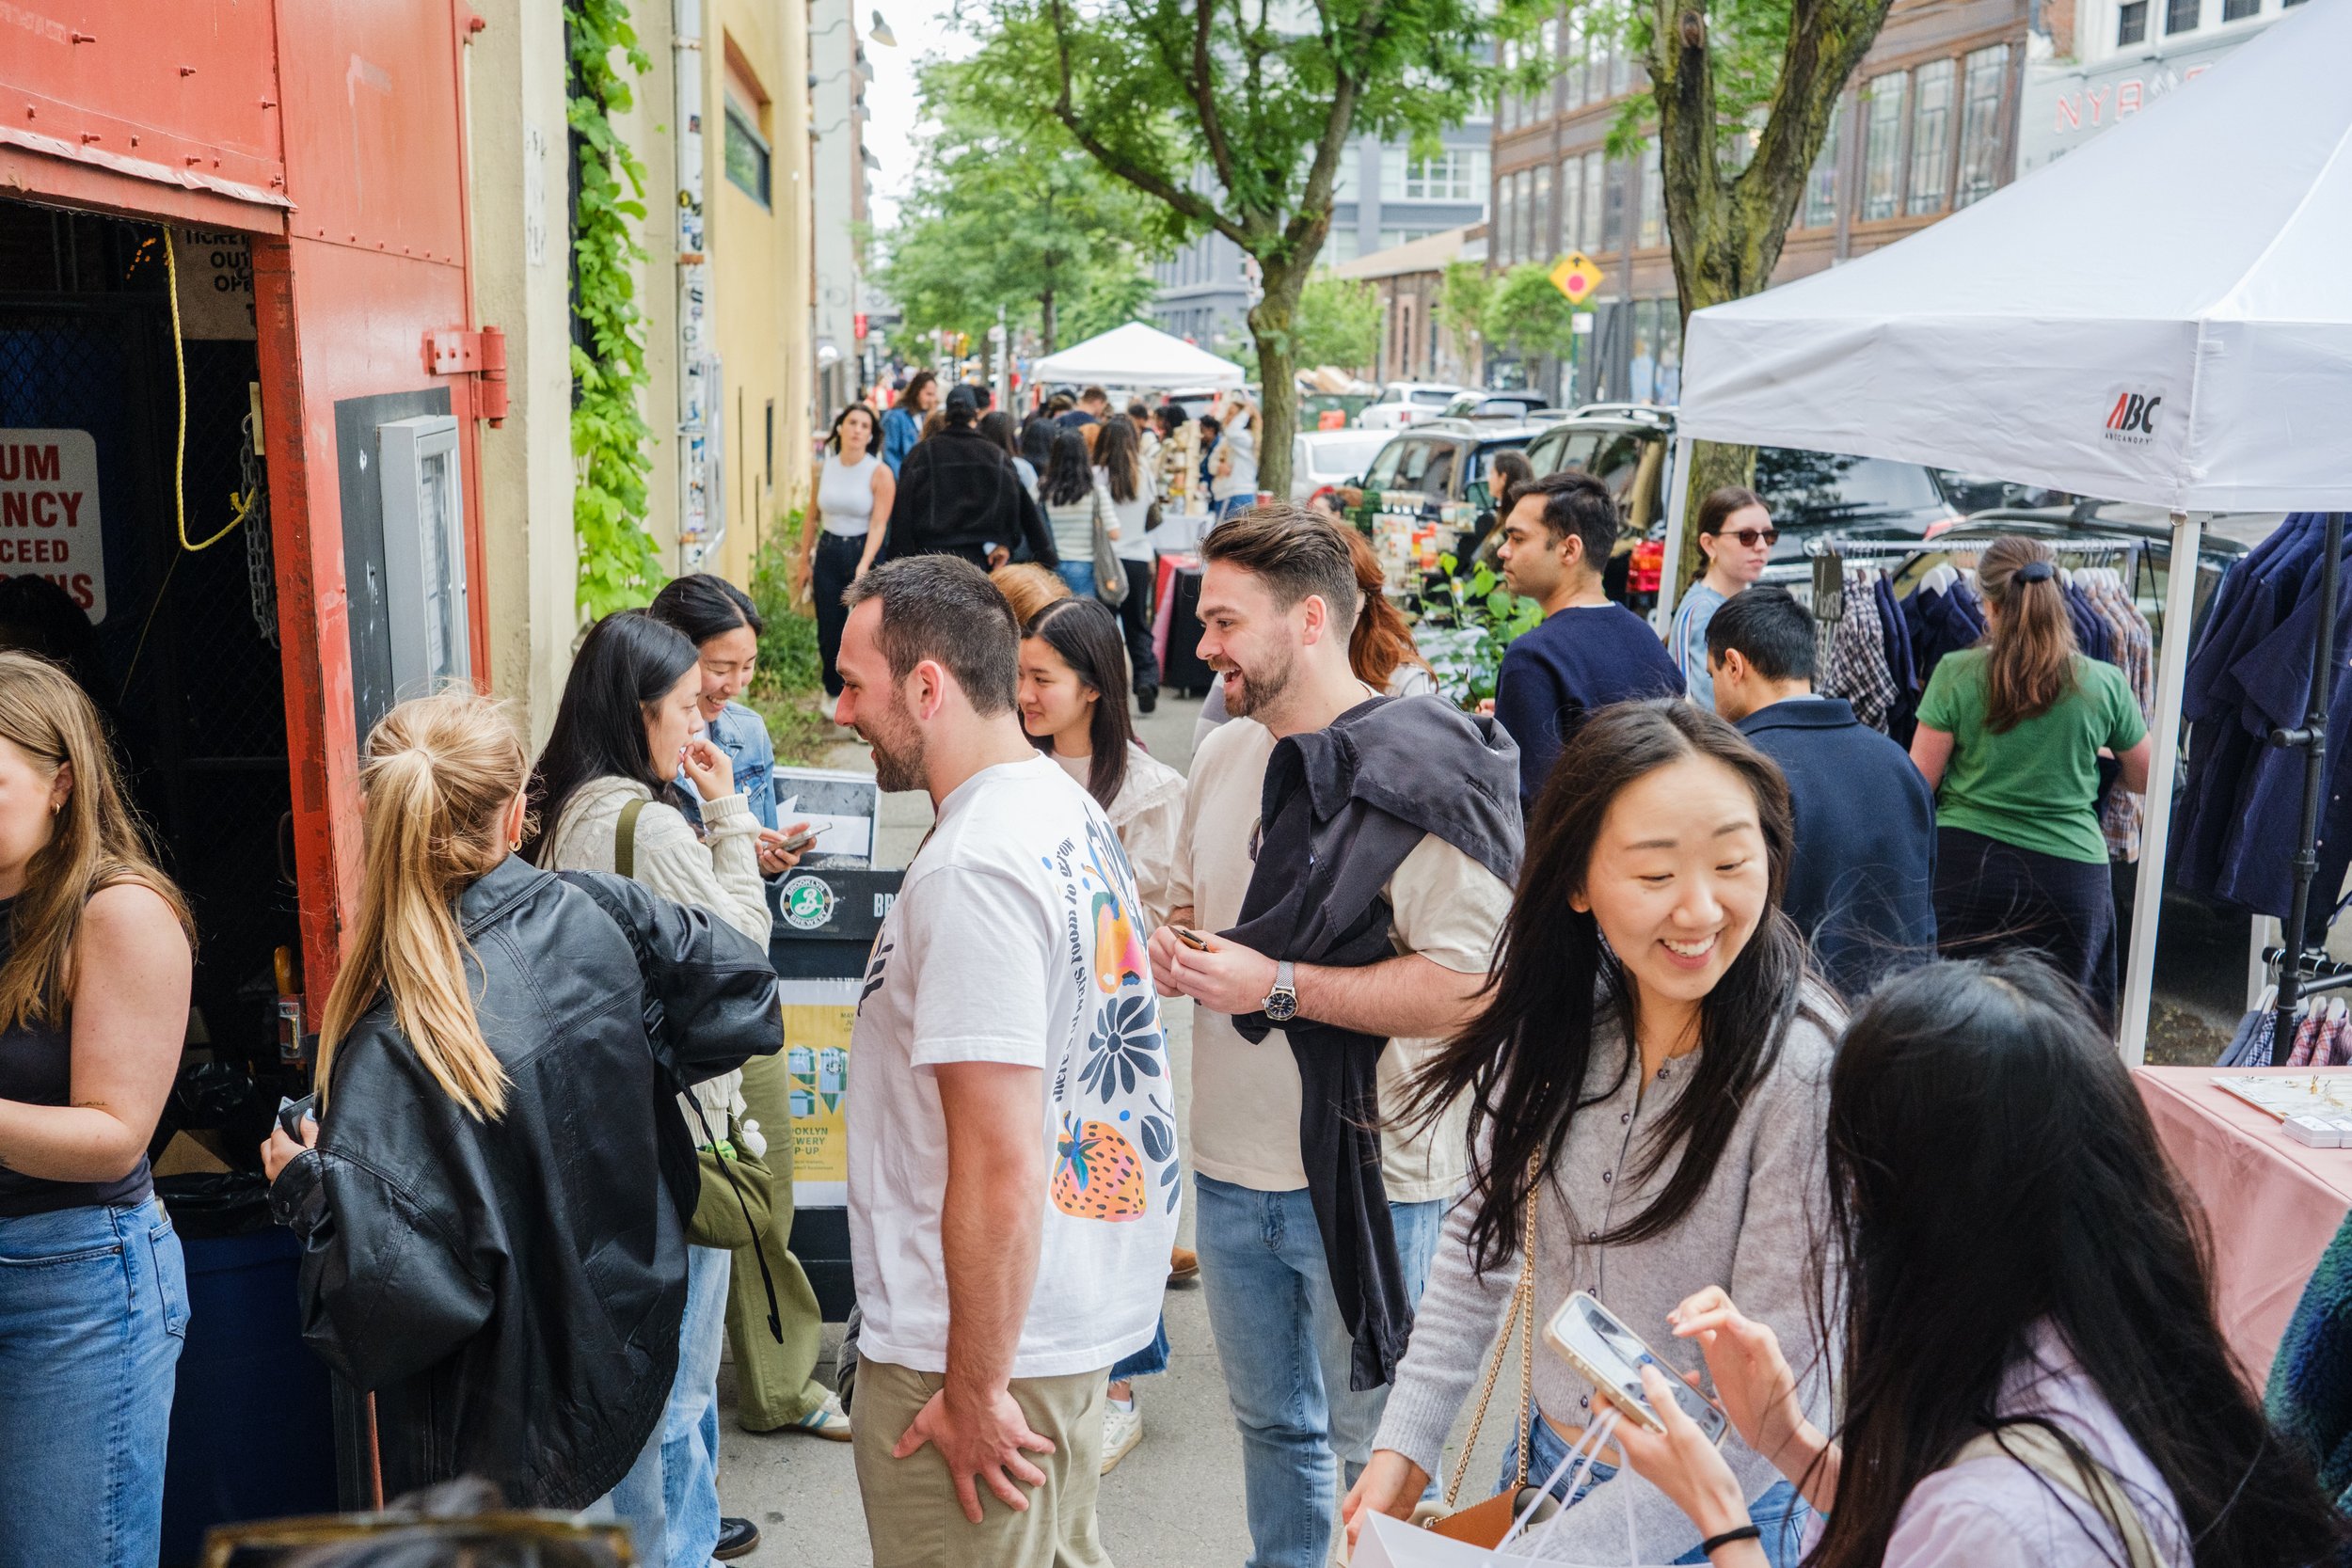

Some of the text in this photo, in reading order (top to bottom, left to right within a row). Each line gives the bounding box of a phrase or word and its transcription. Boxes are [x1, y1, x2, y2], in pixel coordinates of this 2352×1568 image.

[2106, 392, 2162, 434] ABC
[0, 491, 83, 528] NCY
[1057, 837, 1075, 878] grow
[786, 879, 825, 896] BROOKLYN
[1065, 883, 1077, 905] to
[790, 909, 827, 926] BREWERY
[1068, 910, 1083, 966] room
[792, 1127, 828, 1135] OKLYN
